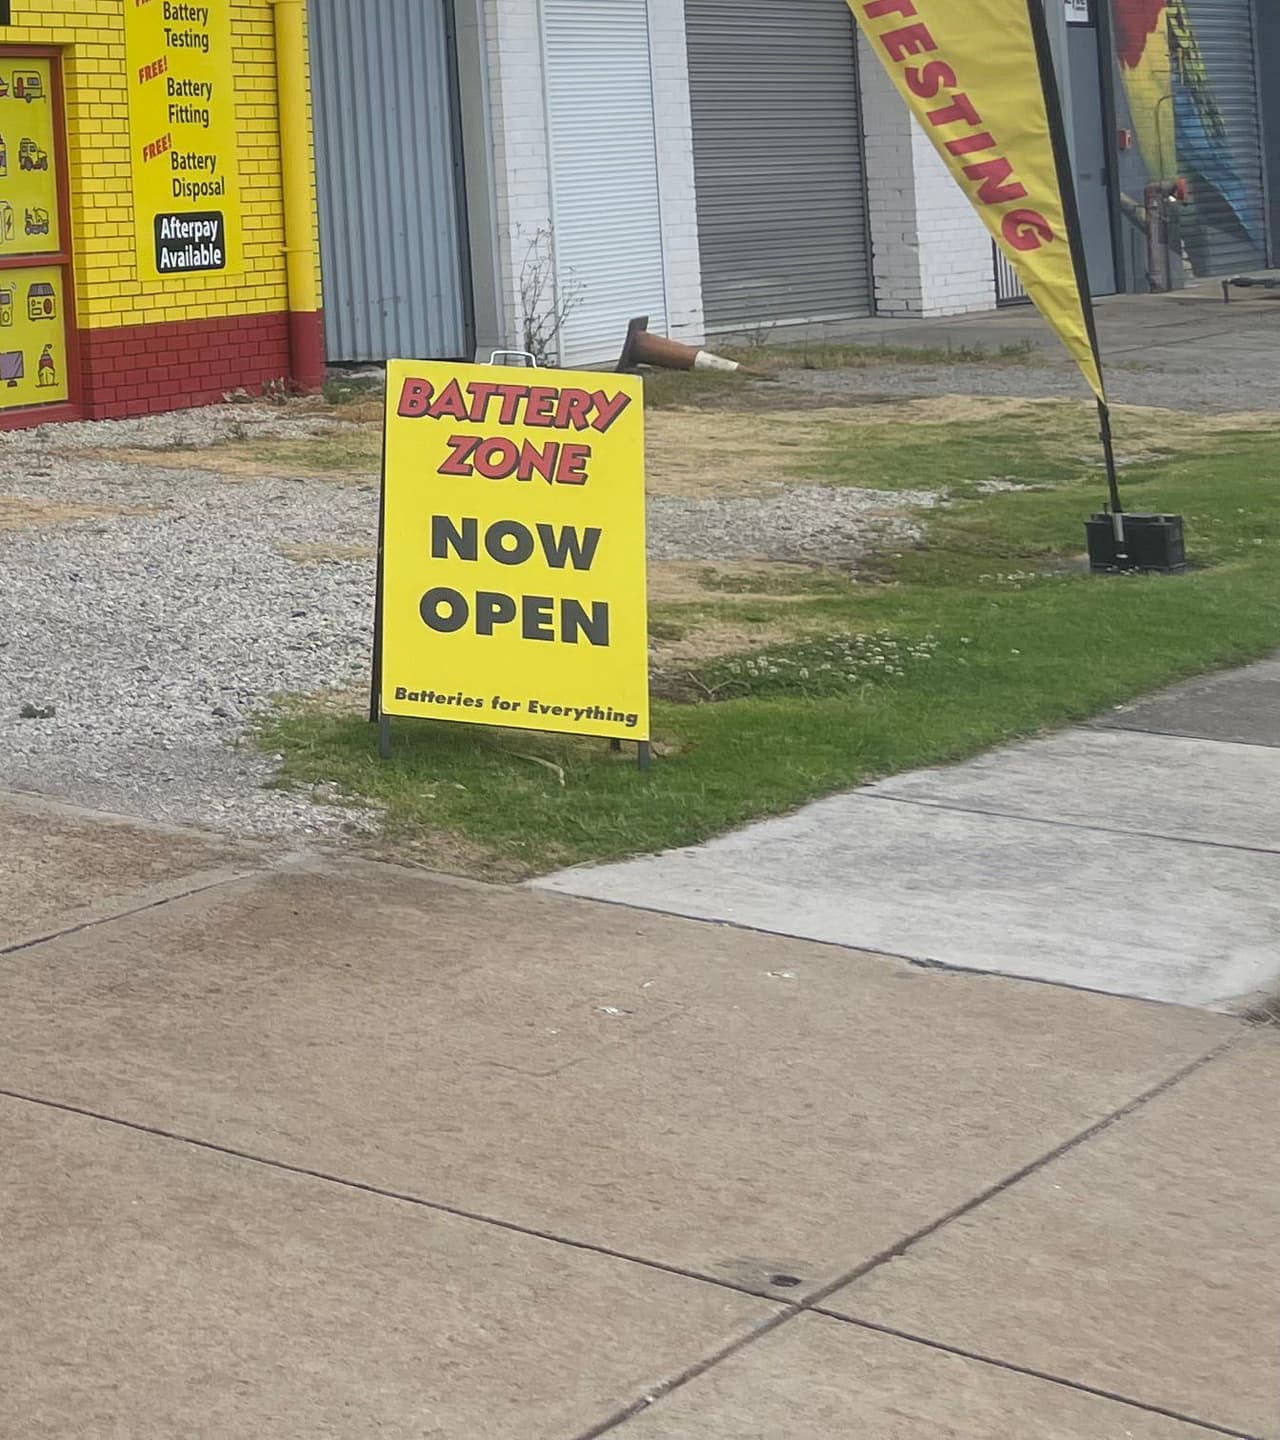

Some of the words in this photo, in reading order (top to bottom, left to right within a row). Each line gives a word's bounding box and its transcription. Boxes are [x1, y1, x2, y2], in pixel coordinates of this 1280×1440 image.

[163, 1, 209, 27] Battery
[164, 28, 209, 53] Testing
[138, 55, 168, 85] FREE!
[167, 77, 212, 101] Battery
[168, 104, 209, 128] Fitting
[142, 133, 172, 163] FREE!
[171, 151, 216, 174] Battery
[172, 176, 225, 202] Disposal
[160, 215, 218, 246] Afterpay
[160, 243, 222, 269] Available
[397, 377, 632, 434] BATTERY
[437, 434, 592, 485] ZONE
[431, 515, 603, 571] NOW
[419, 587, 610, 647] OPEN
[394, 687, 484, 710] Batteries
[491, 695, 521, 713] for
[528, 700, 639, 727] Everything
